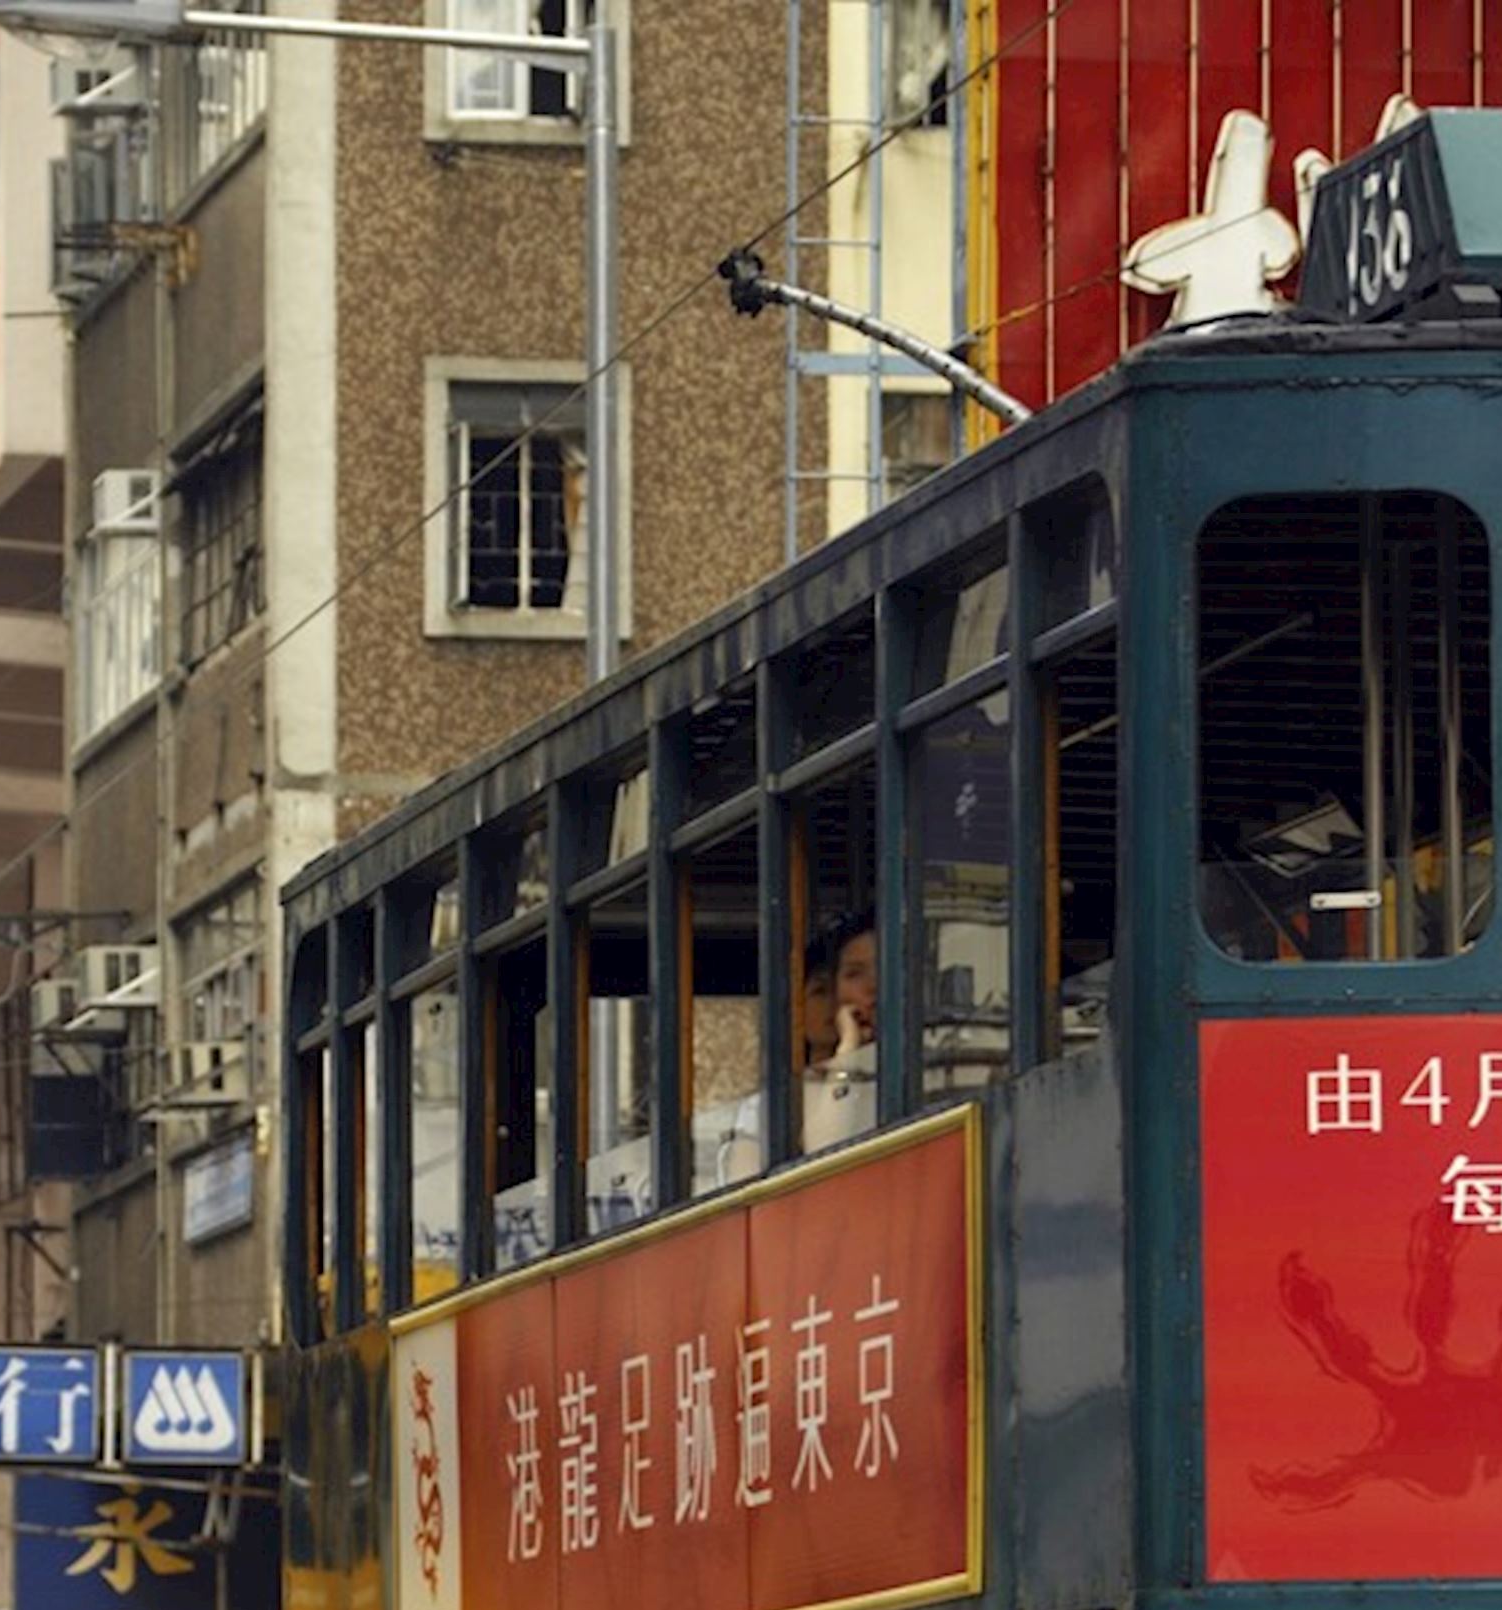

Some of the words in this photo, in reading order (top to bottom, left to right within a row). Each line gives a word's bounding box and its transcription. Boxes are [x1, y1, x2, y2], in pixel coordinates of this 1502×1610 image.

[1347, 158, 1412, 317] 136
[505, 1272, 900, 1564] 港龍足跡遍東京
